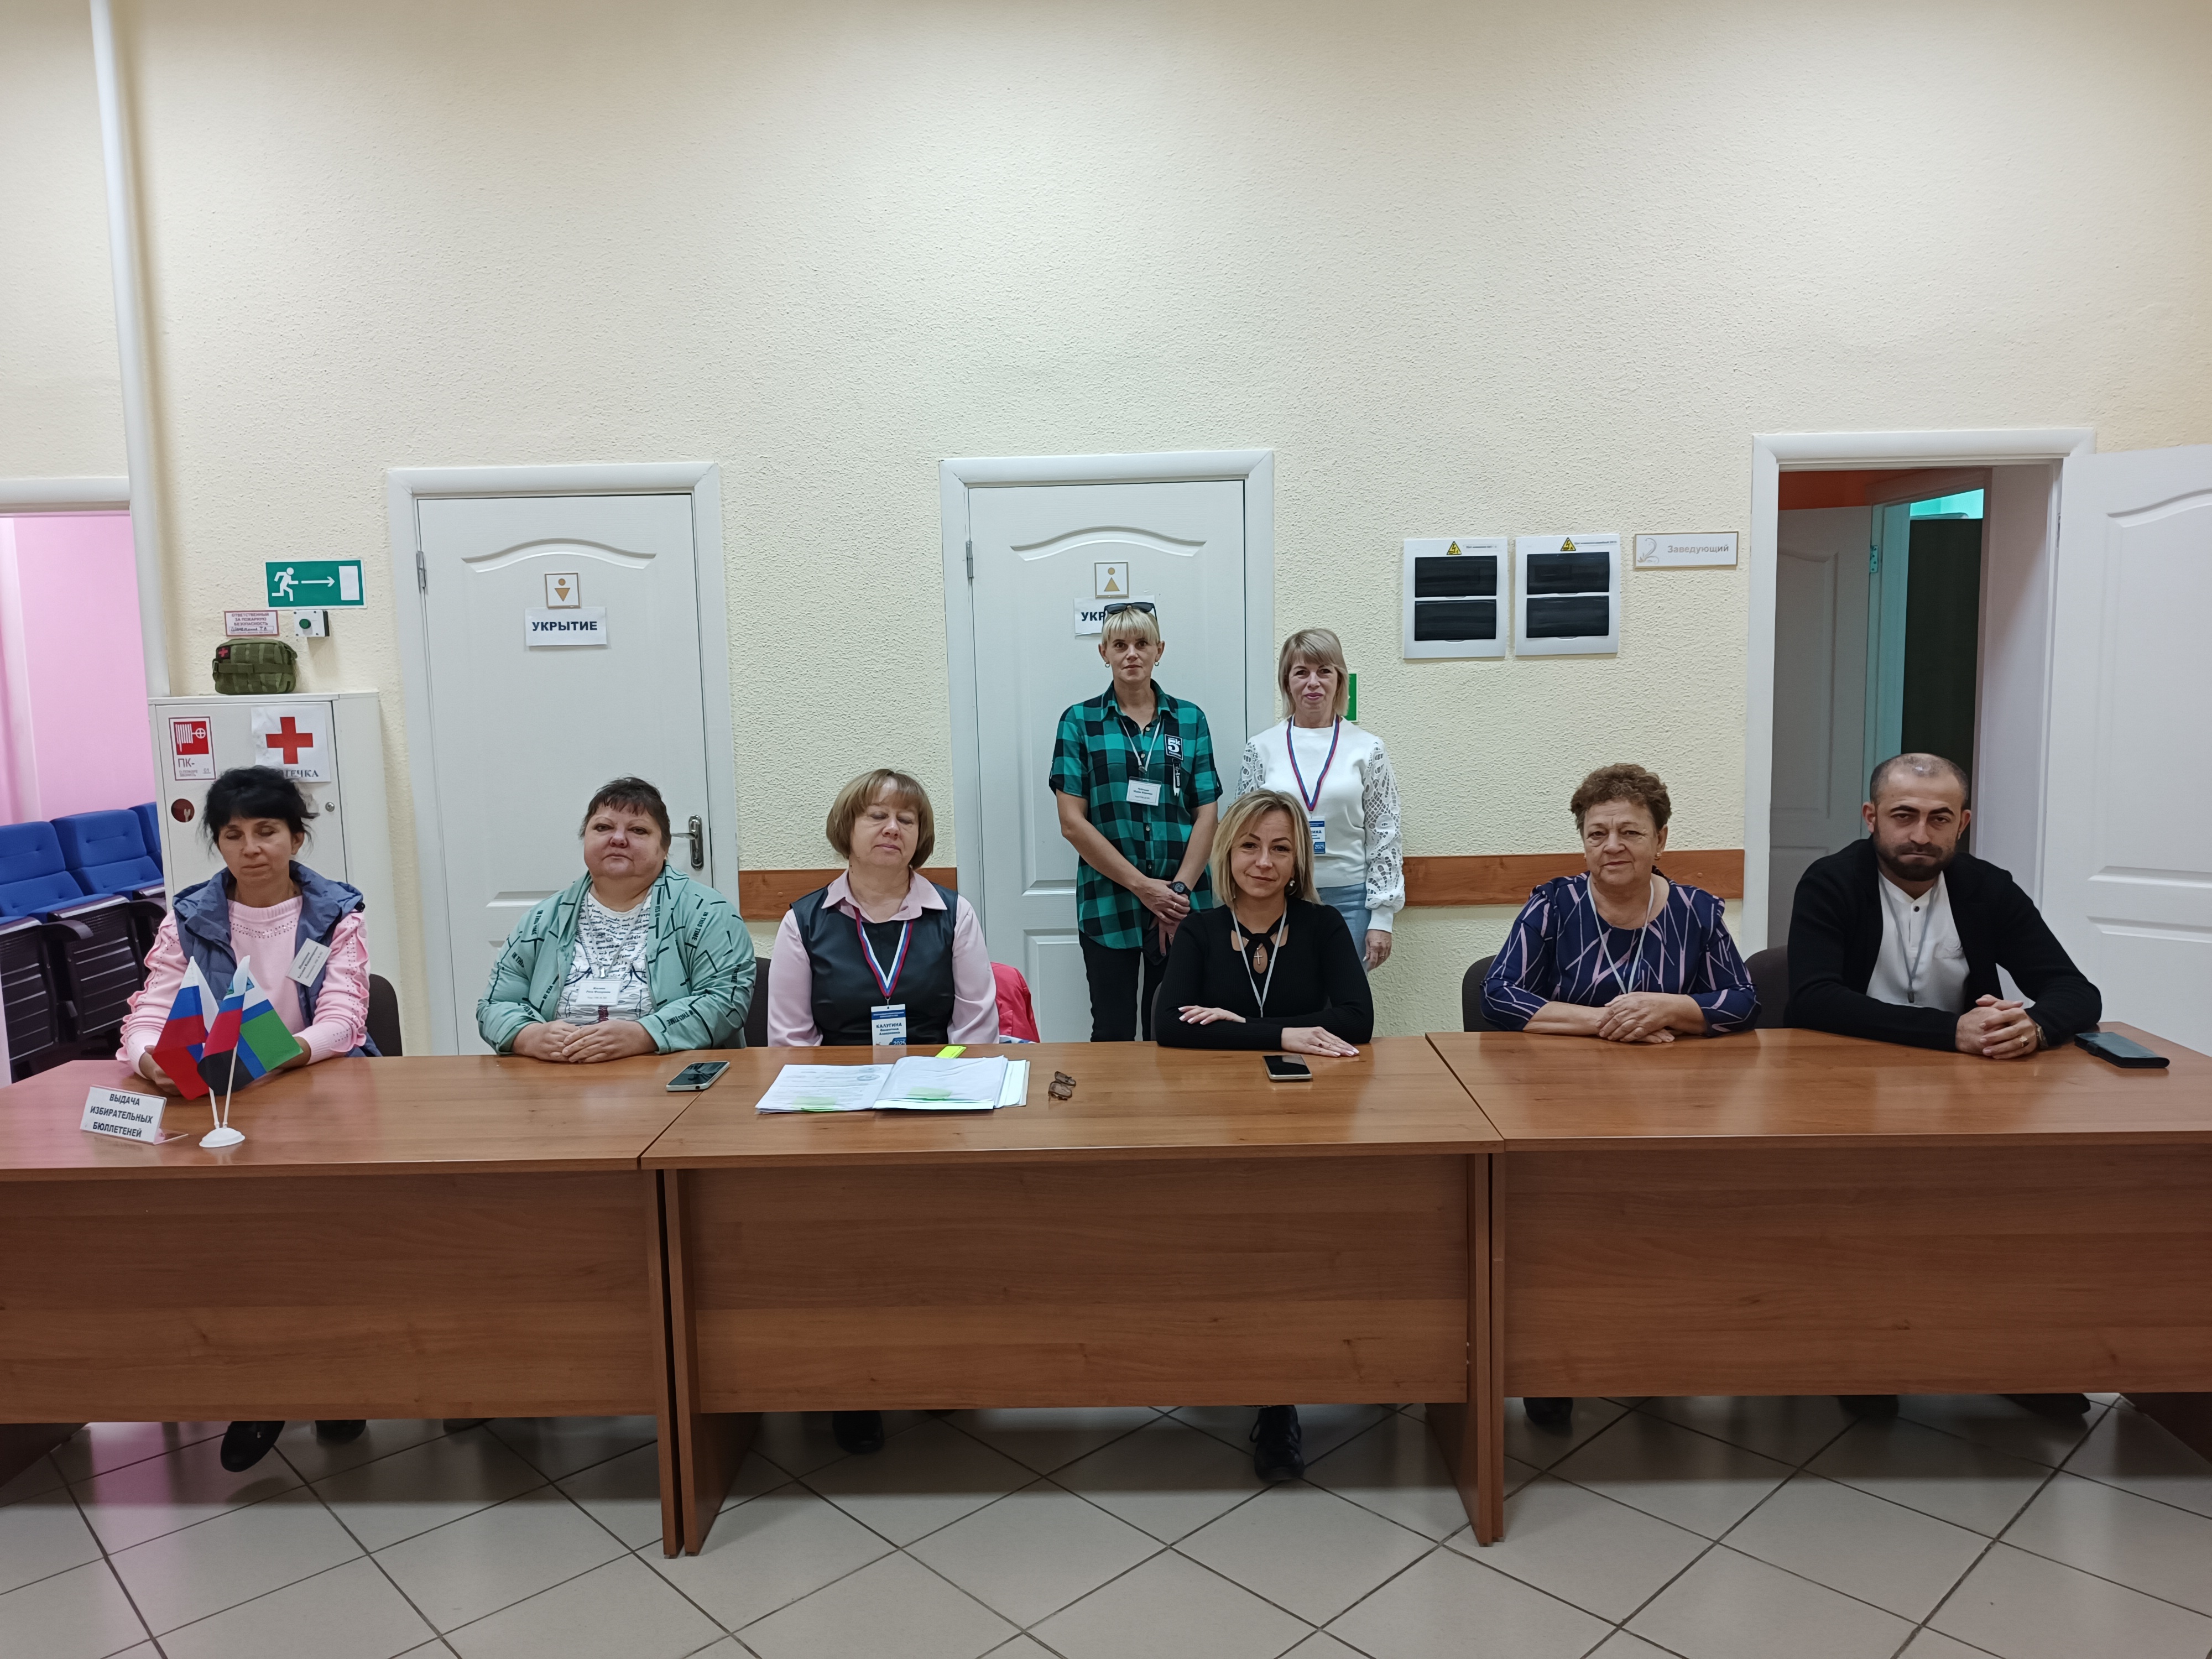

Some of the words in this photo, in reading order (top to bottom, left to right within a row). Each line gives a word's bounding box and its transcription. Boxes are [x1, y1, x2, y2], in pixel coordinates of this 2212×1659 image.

[1667, 544, 1729, 554] Заведующий
[1081, 612, 1104, 622] УКР
[532, 622, 597, 631] УКРЫТИЕ
[697, 917, 706, 927] THIS
[691, 927, 701, 941] TIME
[666, 1016, 680, 1026] TIME
[109, 1093, 140, 1106] ВЫДАЧА
[90, 1105, 153, 1124] ИЗБИРАТЕЛЬНЫХ
[92, 1121, 142, 1138] БЮЛЛЕТЕНЕЙ
